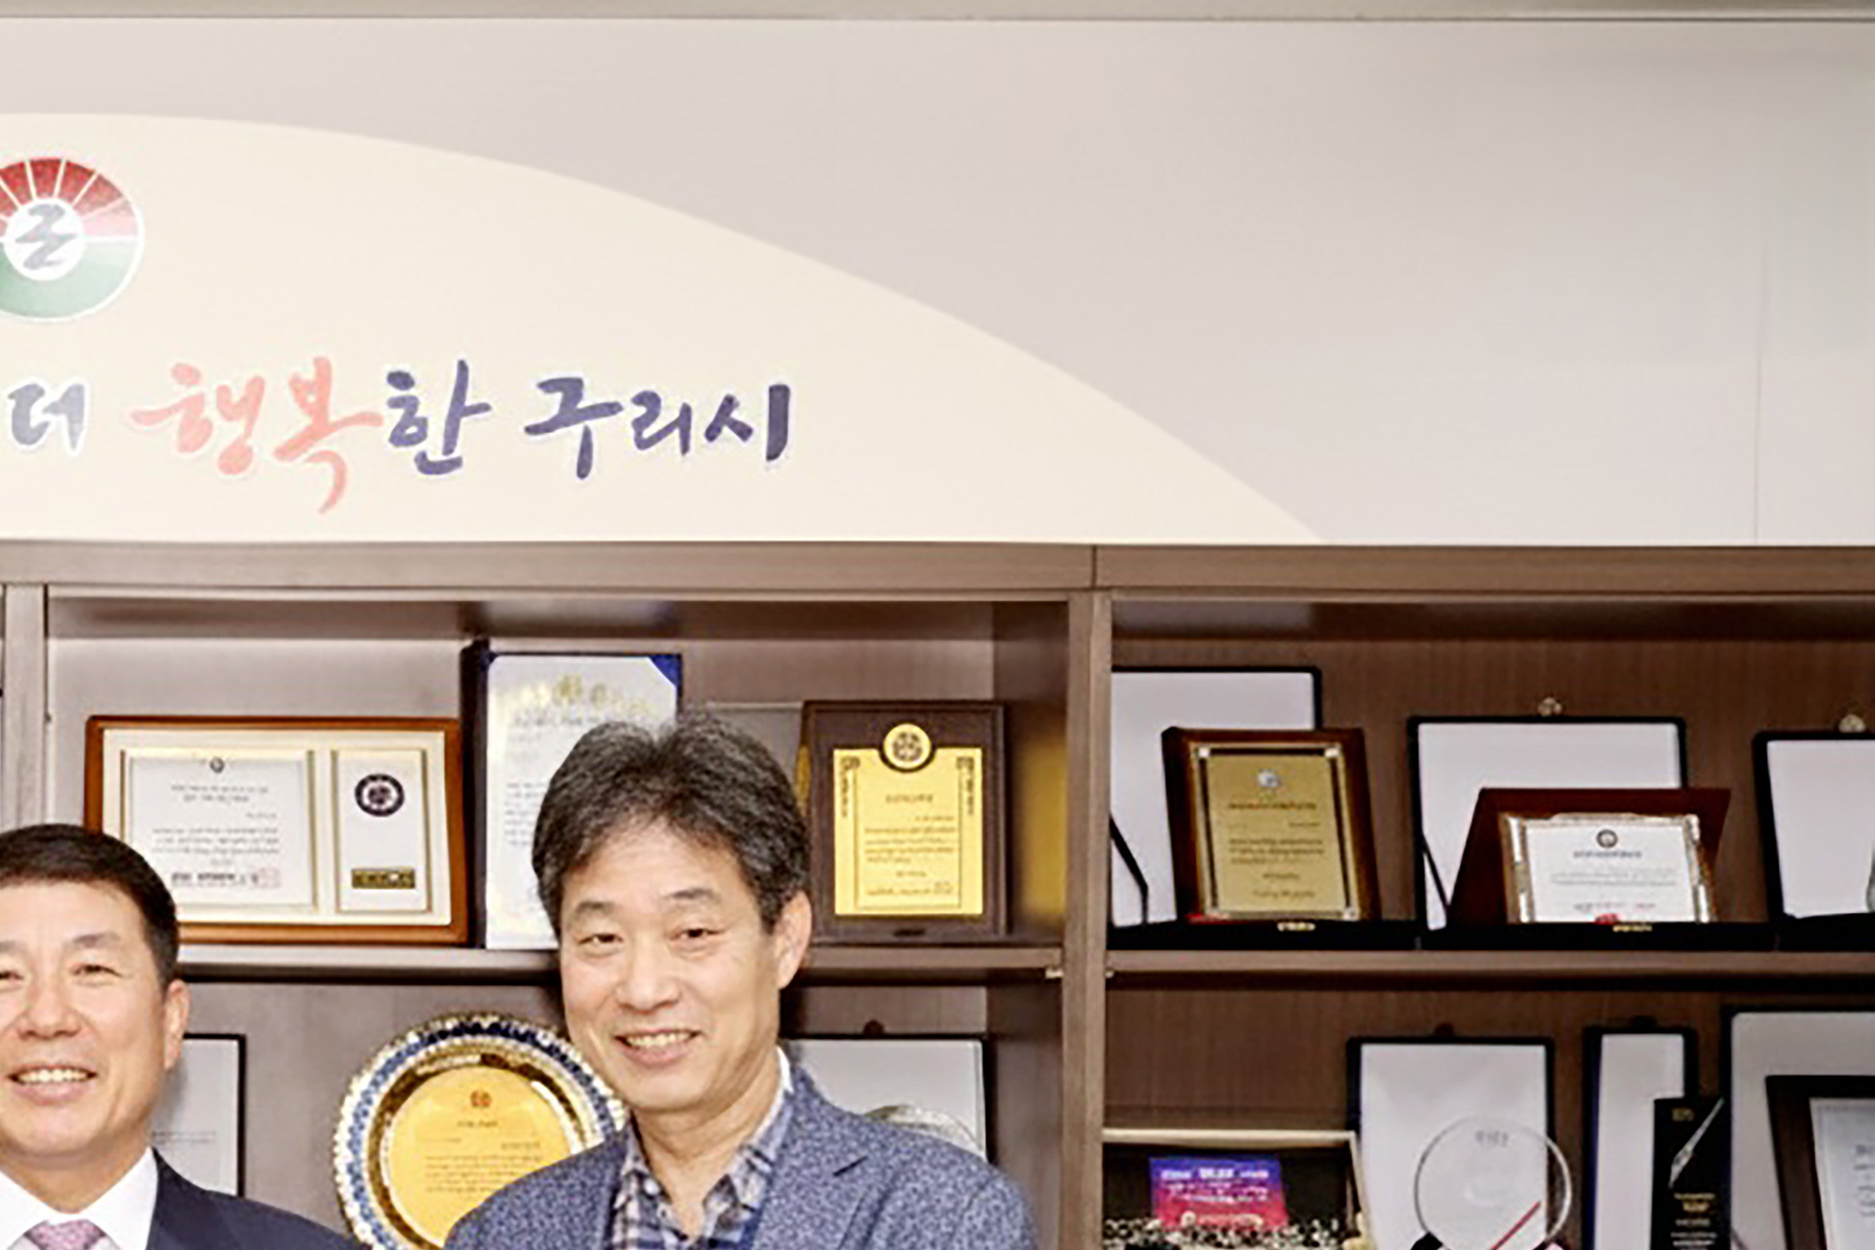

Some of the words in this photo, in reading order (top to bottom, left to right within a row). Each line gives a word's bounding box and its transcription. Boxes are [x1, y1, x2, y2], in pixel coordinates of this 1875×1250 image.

[11, 379, 87, 456] 더
[131, 356, 493, 512] 행복한
[522, 376, 793, 481] 구리시
